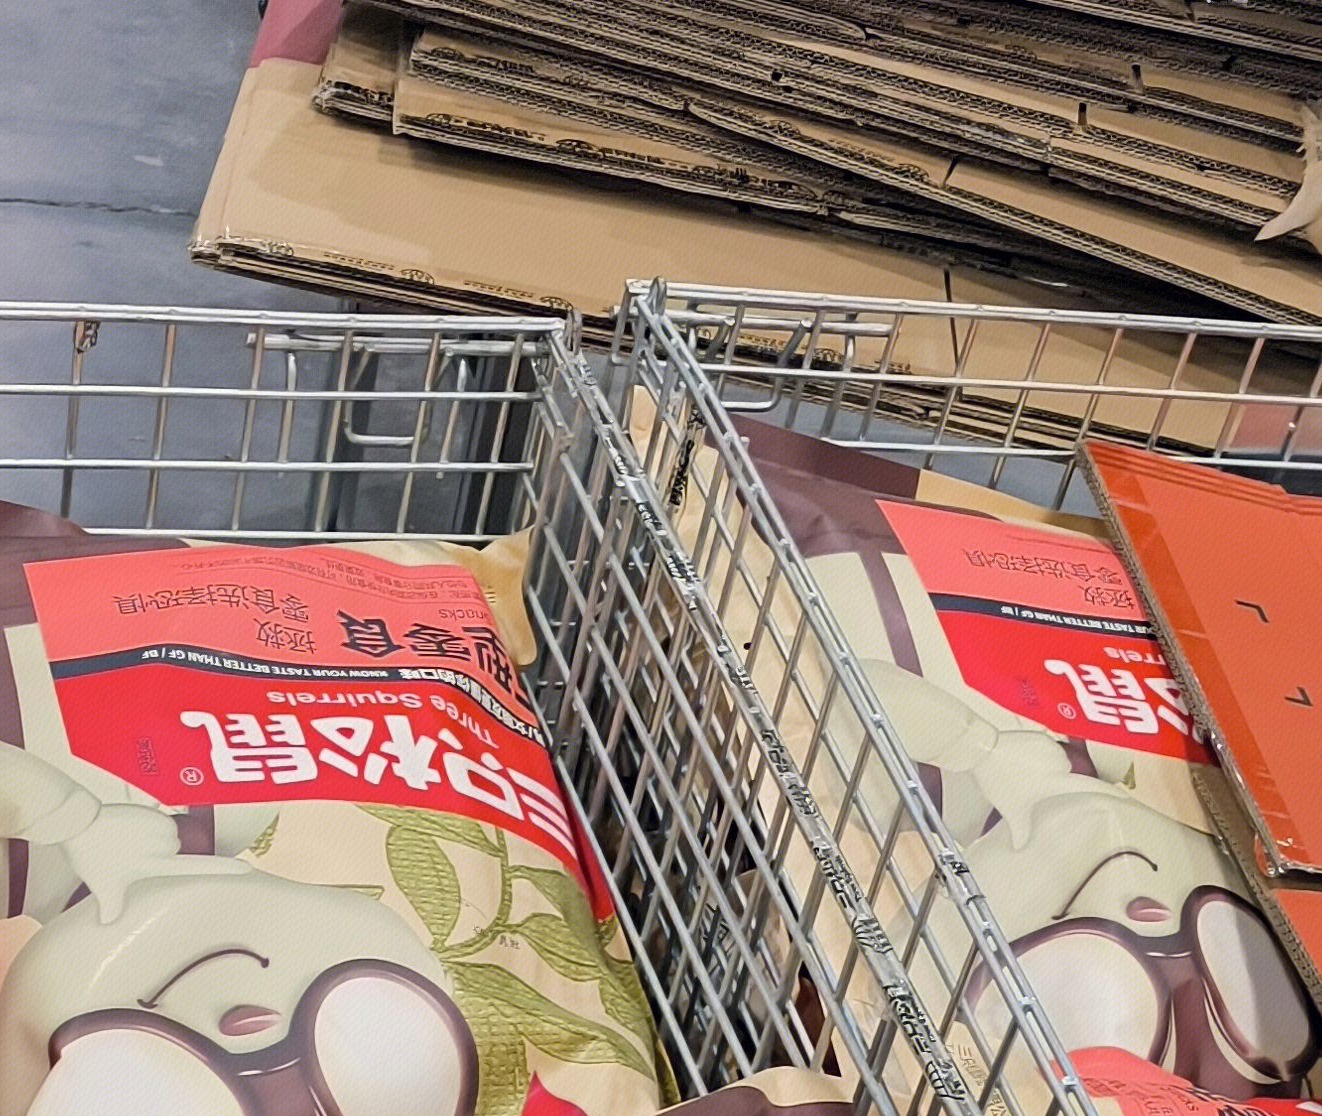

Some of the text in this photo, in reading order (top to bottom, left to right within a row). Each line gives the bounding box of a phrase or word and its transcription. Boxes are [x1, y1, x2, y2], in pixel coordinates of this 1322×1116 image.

[114, 581, 310, 622] 零食选择恐惧
[256, 618, 317, 654] 拯救
[141, 648, 158, 659] BF
[187, 651, 221, 665] THAN
[221, 657, 269, 673] BETTER
[270, 662, 311, 677] TASTE
[312, 667, 353, 679] YOUR
[266, 689, 499, 750] Three Squirrels
[180, 710, 579, 859] 三只松鼠
